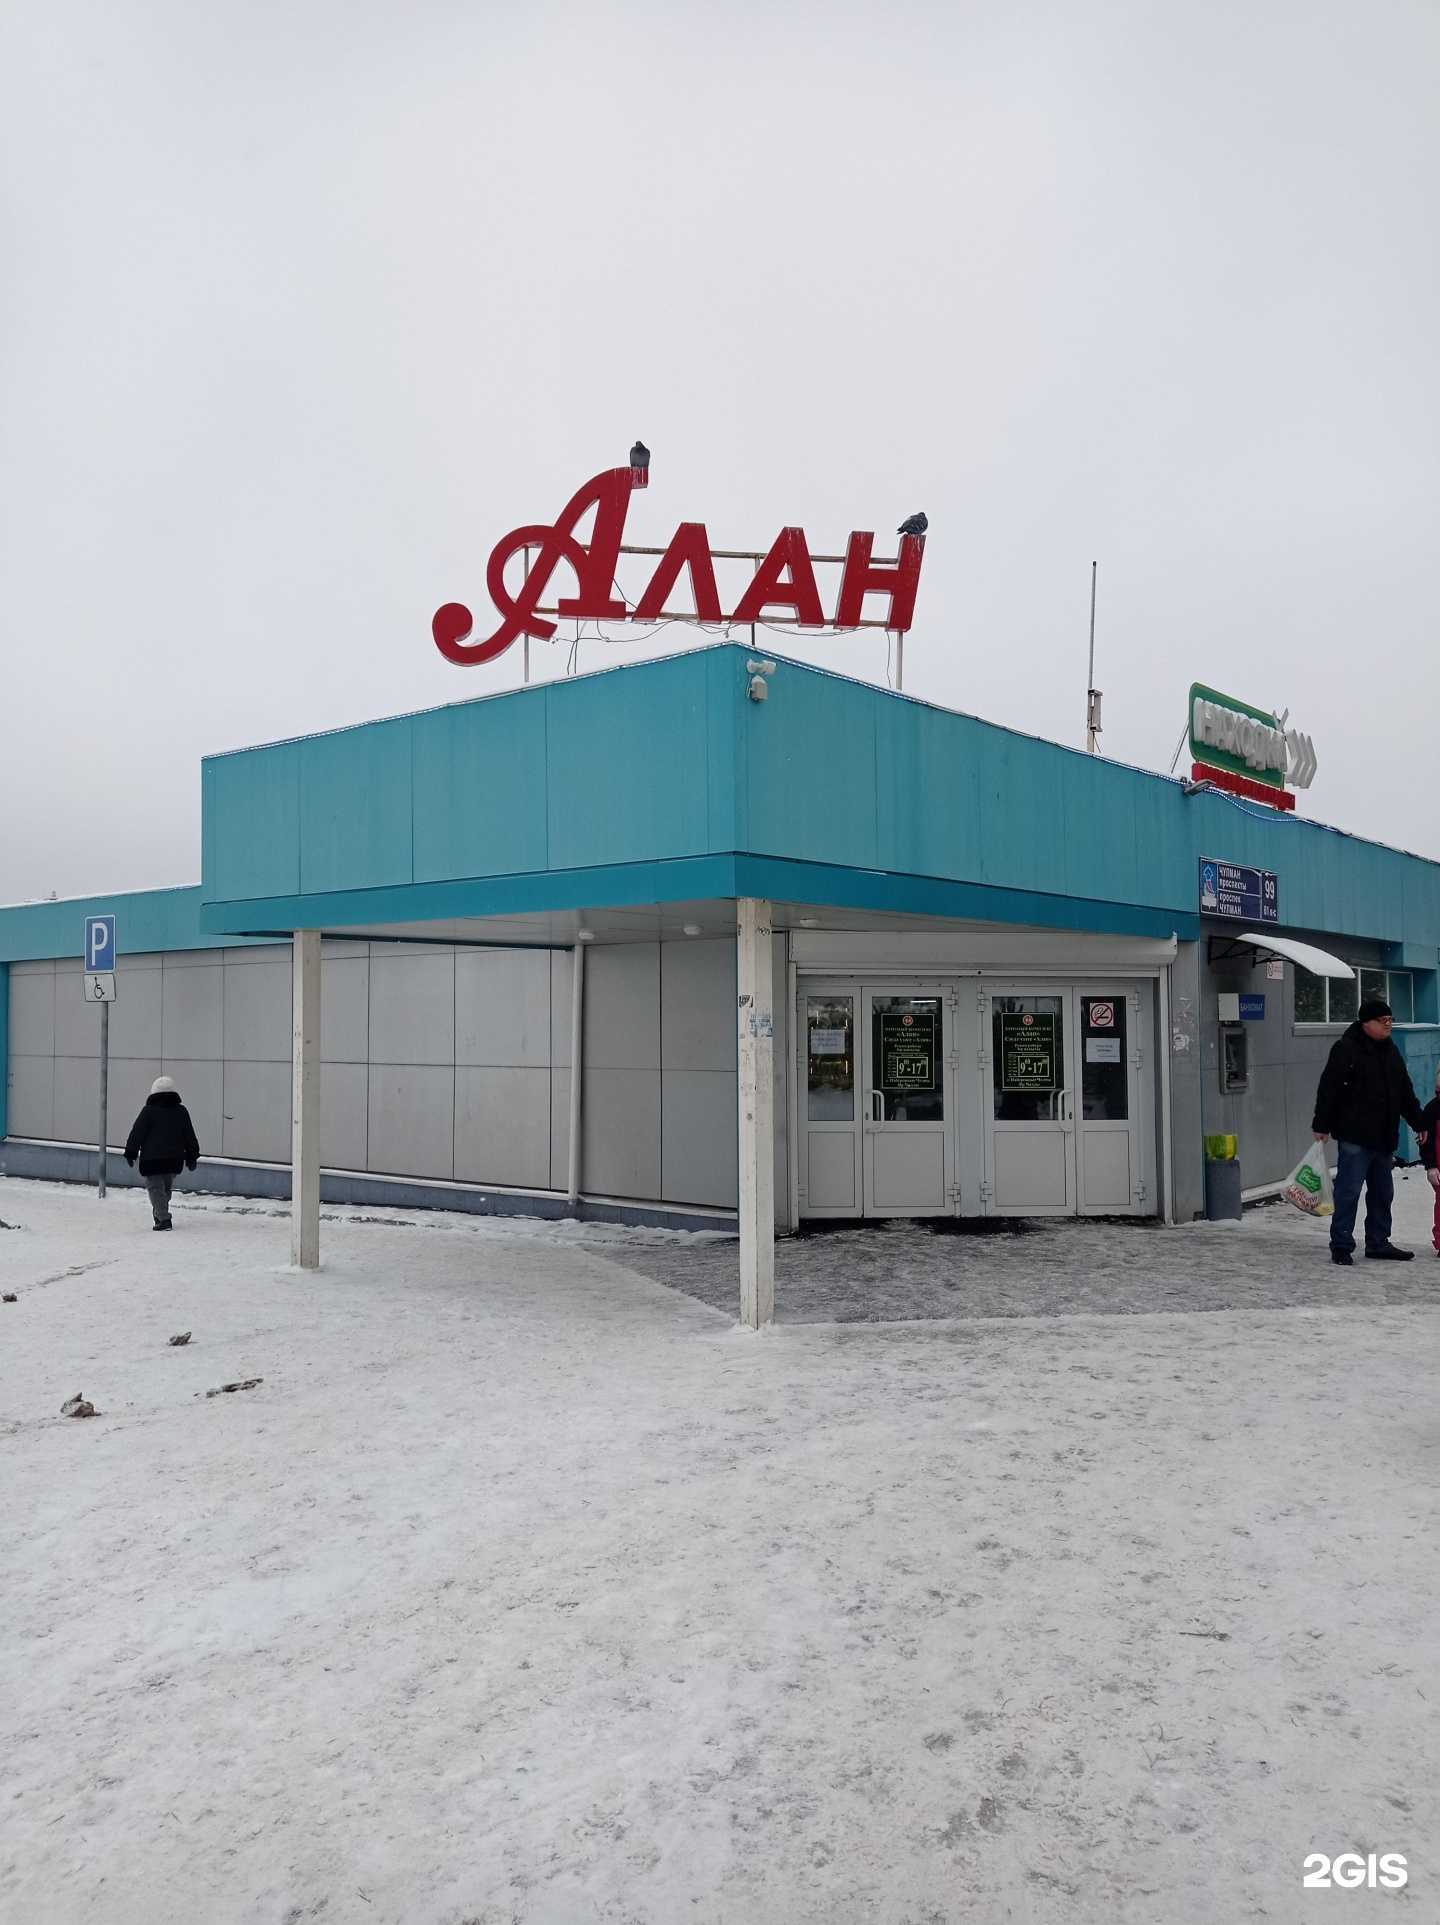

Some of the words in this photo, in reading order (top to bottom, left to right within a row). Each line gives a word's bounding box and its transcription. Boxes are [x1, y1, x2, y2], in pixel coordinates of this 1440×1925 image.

[1219, 866, 1241, 879] ЧУЛМАН
[1219, 878, 1247, 890] проспекты
[1264, 880, 1275, 899] 99
[1219, 903, 1242, 916] ЧУЛМАН
